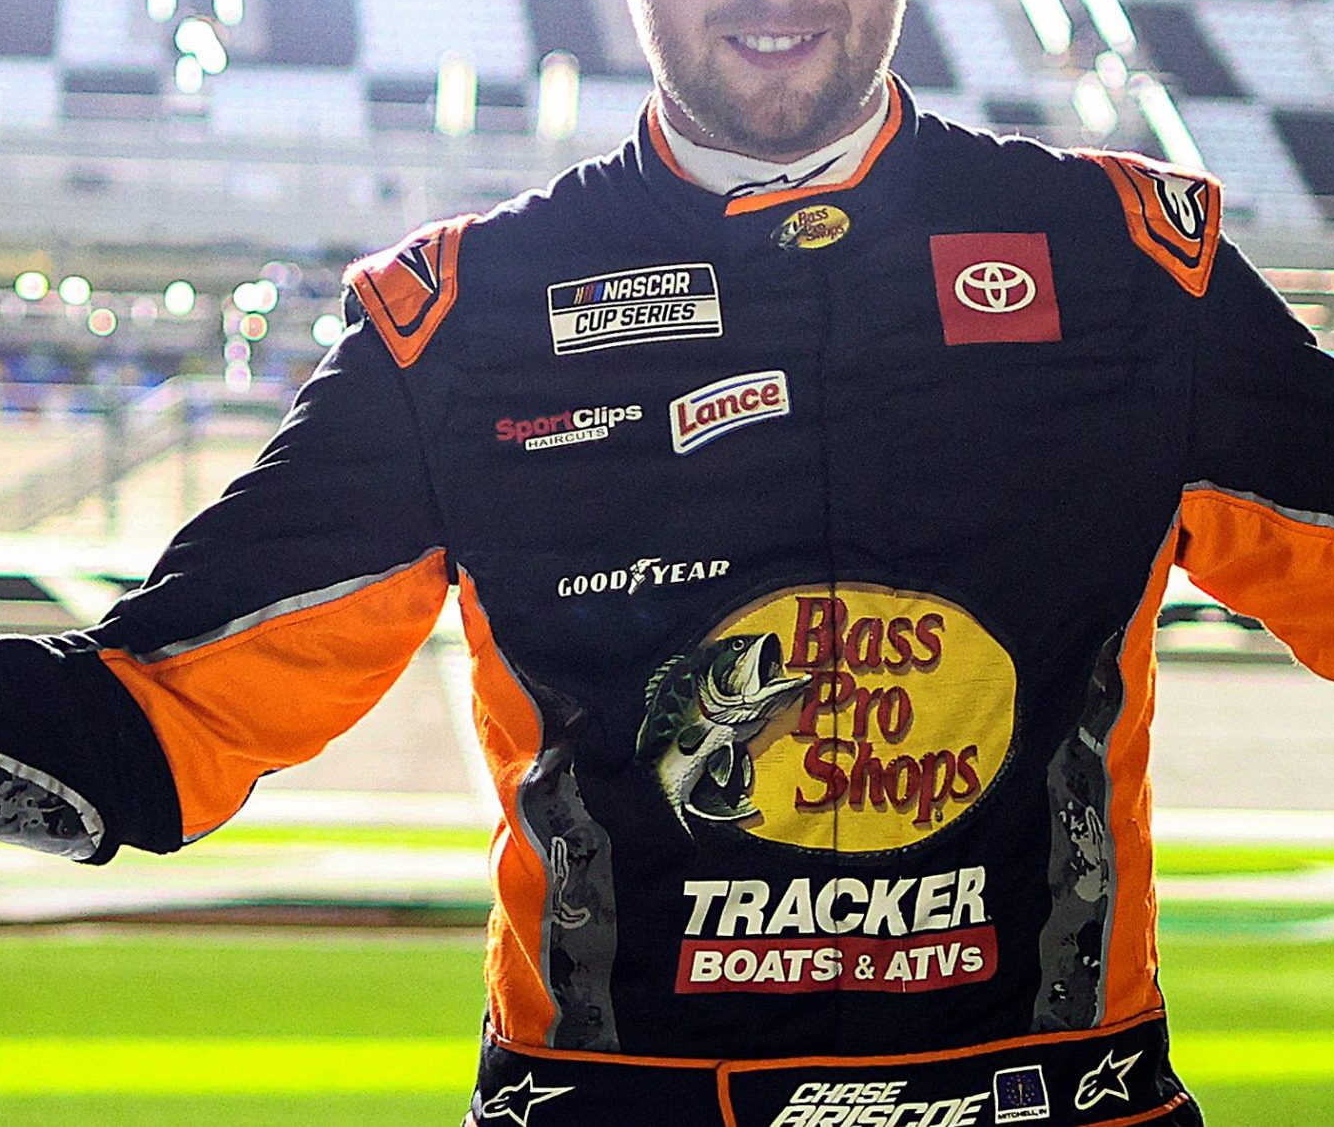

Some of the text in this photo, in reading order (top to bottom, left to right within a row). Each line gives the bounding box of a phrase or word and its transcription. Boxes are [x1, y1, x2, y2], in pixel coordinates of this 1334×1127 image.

[798, 208, 829, 228] Bass
[603, 272, 690, 301] NASCAR
[575, 302, 696, 335] CUP SERIES
[495, 404, 644, 442] SportClips
[677, 382, 781, 436] Lance
[528, 427, 606, 449] HAIRCUTS
[784, 596, 946, 674] Bass
[791, 670, 915, 745] Pro
[795, 738, 983, 829] Shops
[683, 865, 987, 937] TRACKER
[689, 942, 985, 983] BOATS & ATVs
[769, 1091, 991, 1127] BRISCOE
[789, 1081, 908, 1105] CHASE
